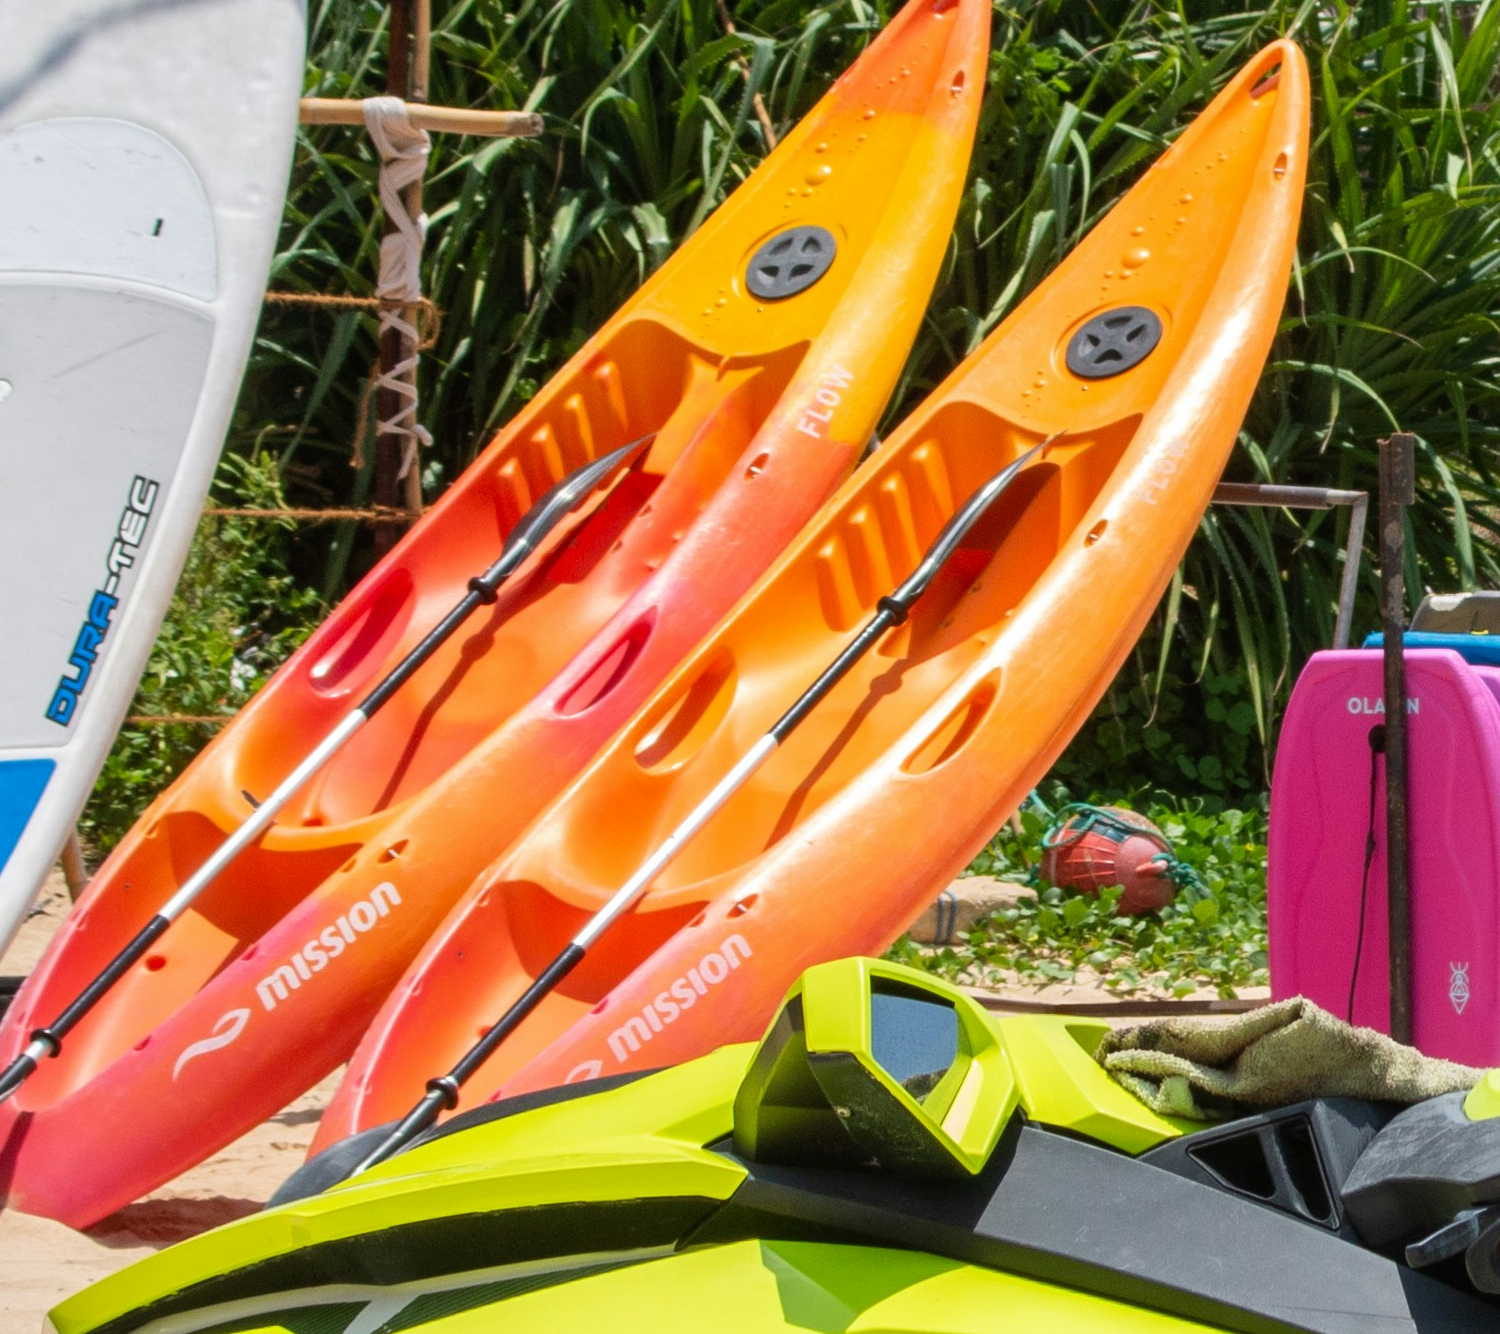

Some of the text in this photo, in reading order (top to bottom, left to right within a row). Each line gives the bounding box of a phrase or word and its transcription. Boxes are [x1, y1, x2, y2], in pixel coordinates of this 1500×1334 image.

[796, 364, 854, 438] FLOW
[44, 473, 161, 727] DURA-TEC
[255, 881, 402, 1012] mission
[607, 933, 753, 1064] mission
